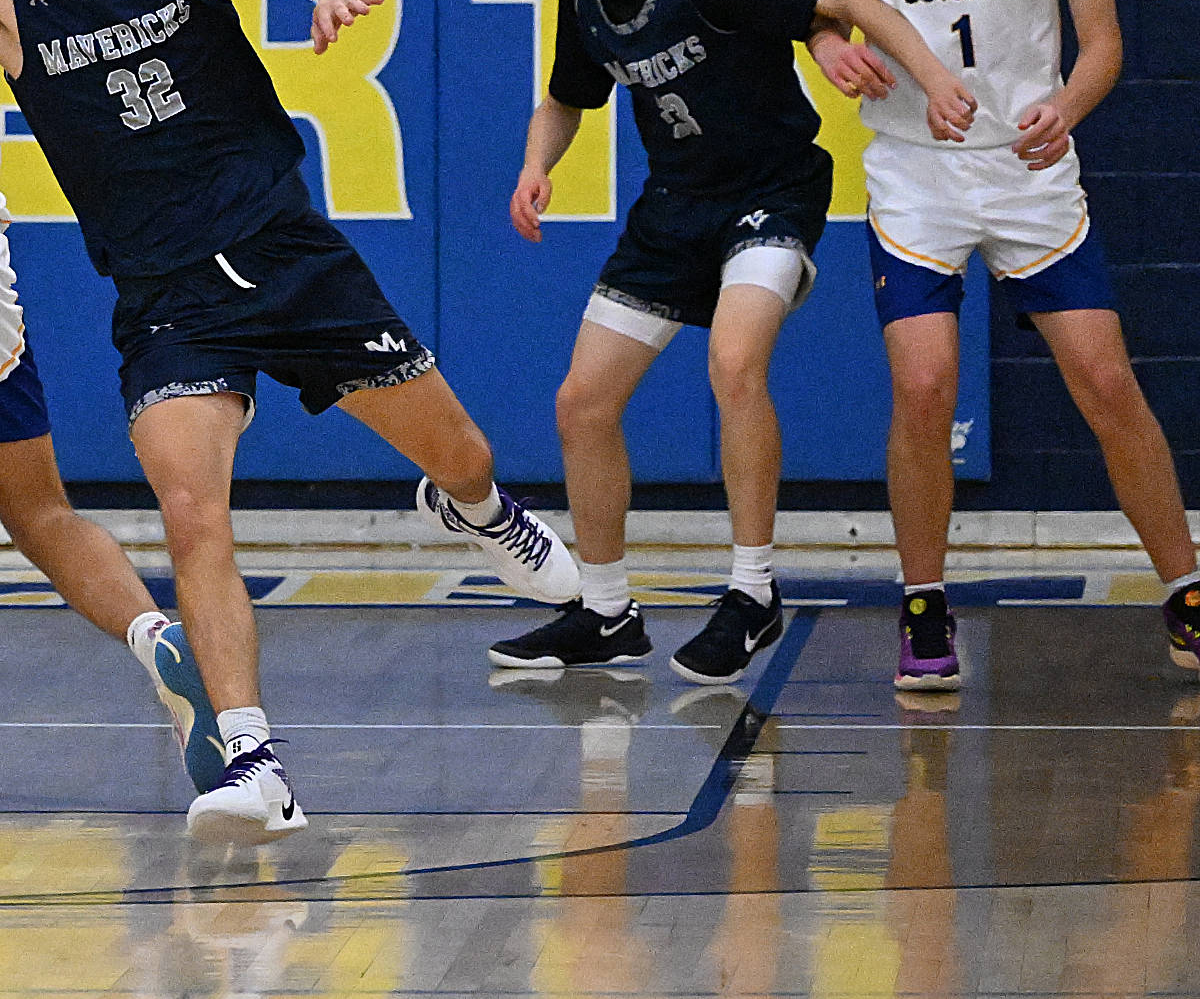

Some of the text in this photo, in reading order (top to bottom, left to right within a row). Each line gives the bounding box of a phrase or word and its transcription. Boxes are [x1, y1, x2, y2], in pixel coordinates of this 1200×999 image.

[950, 13, 975, 68] 1
[106, 58, 186, 130] 32
[655, 92, 703, 139] 3
